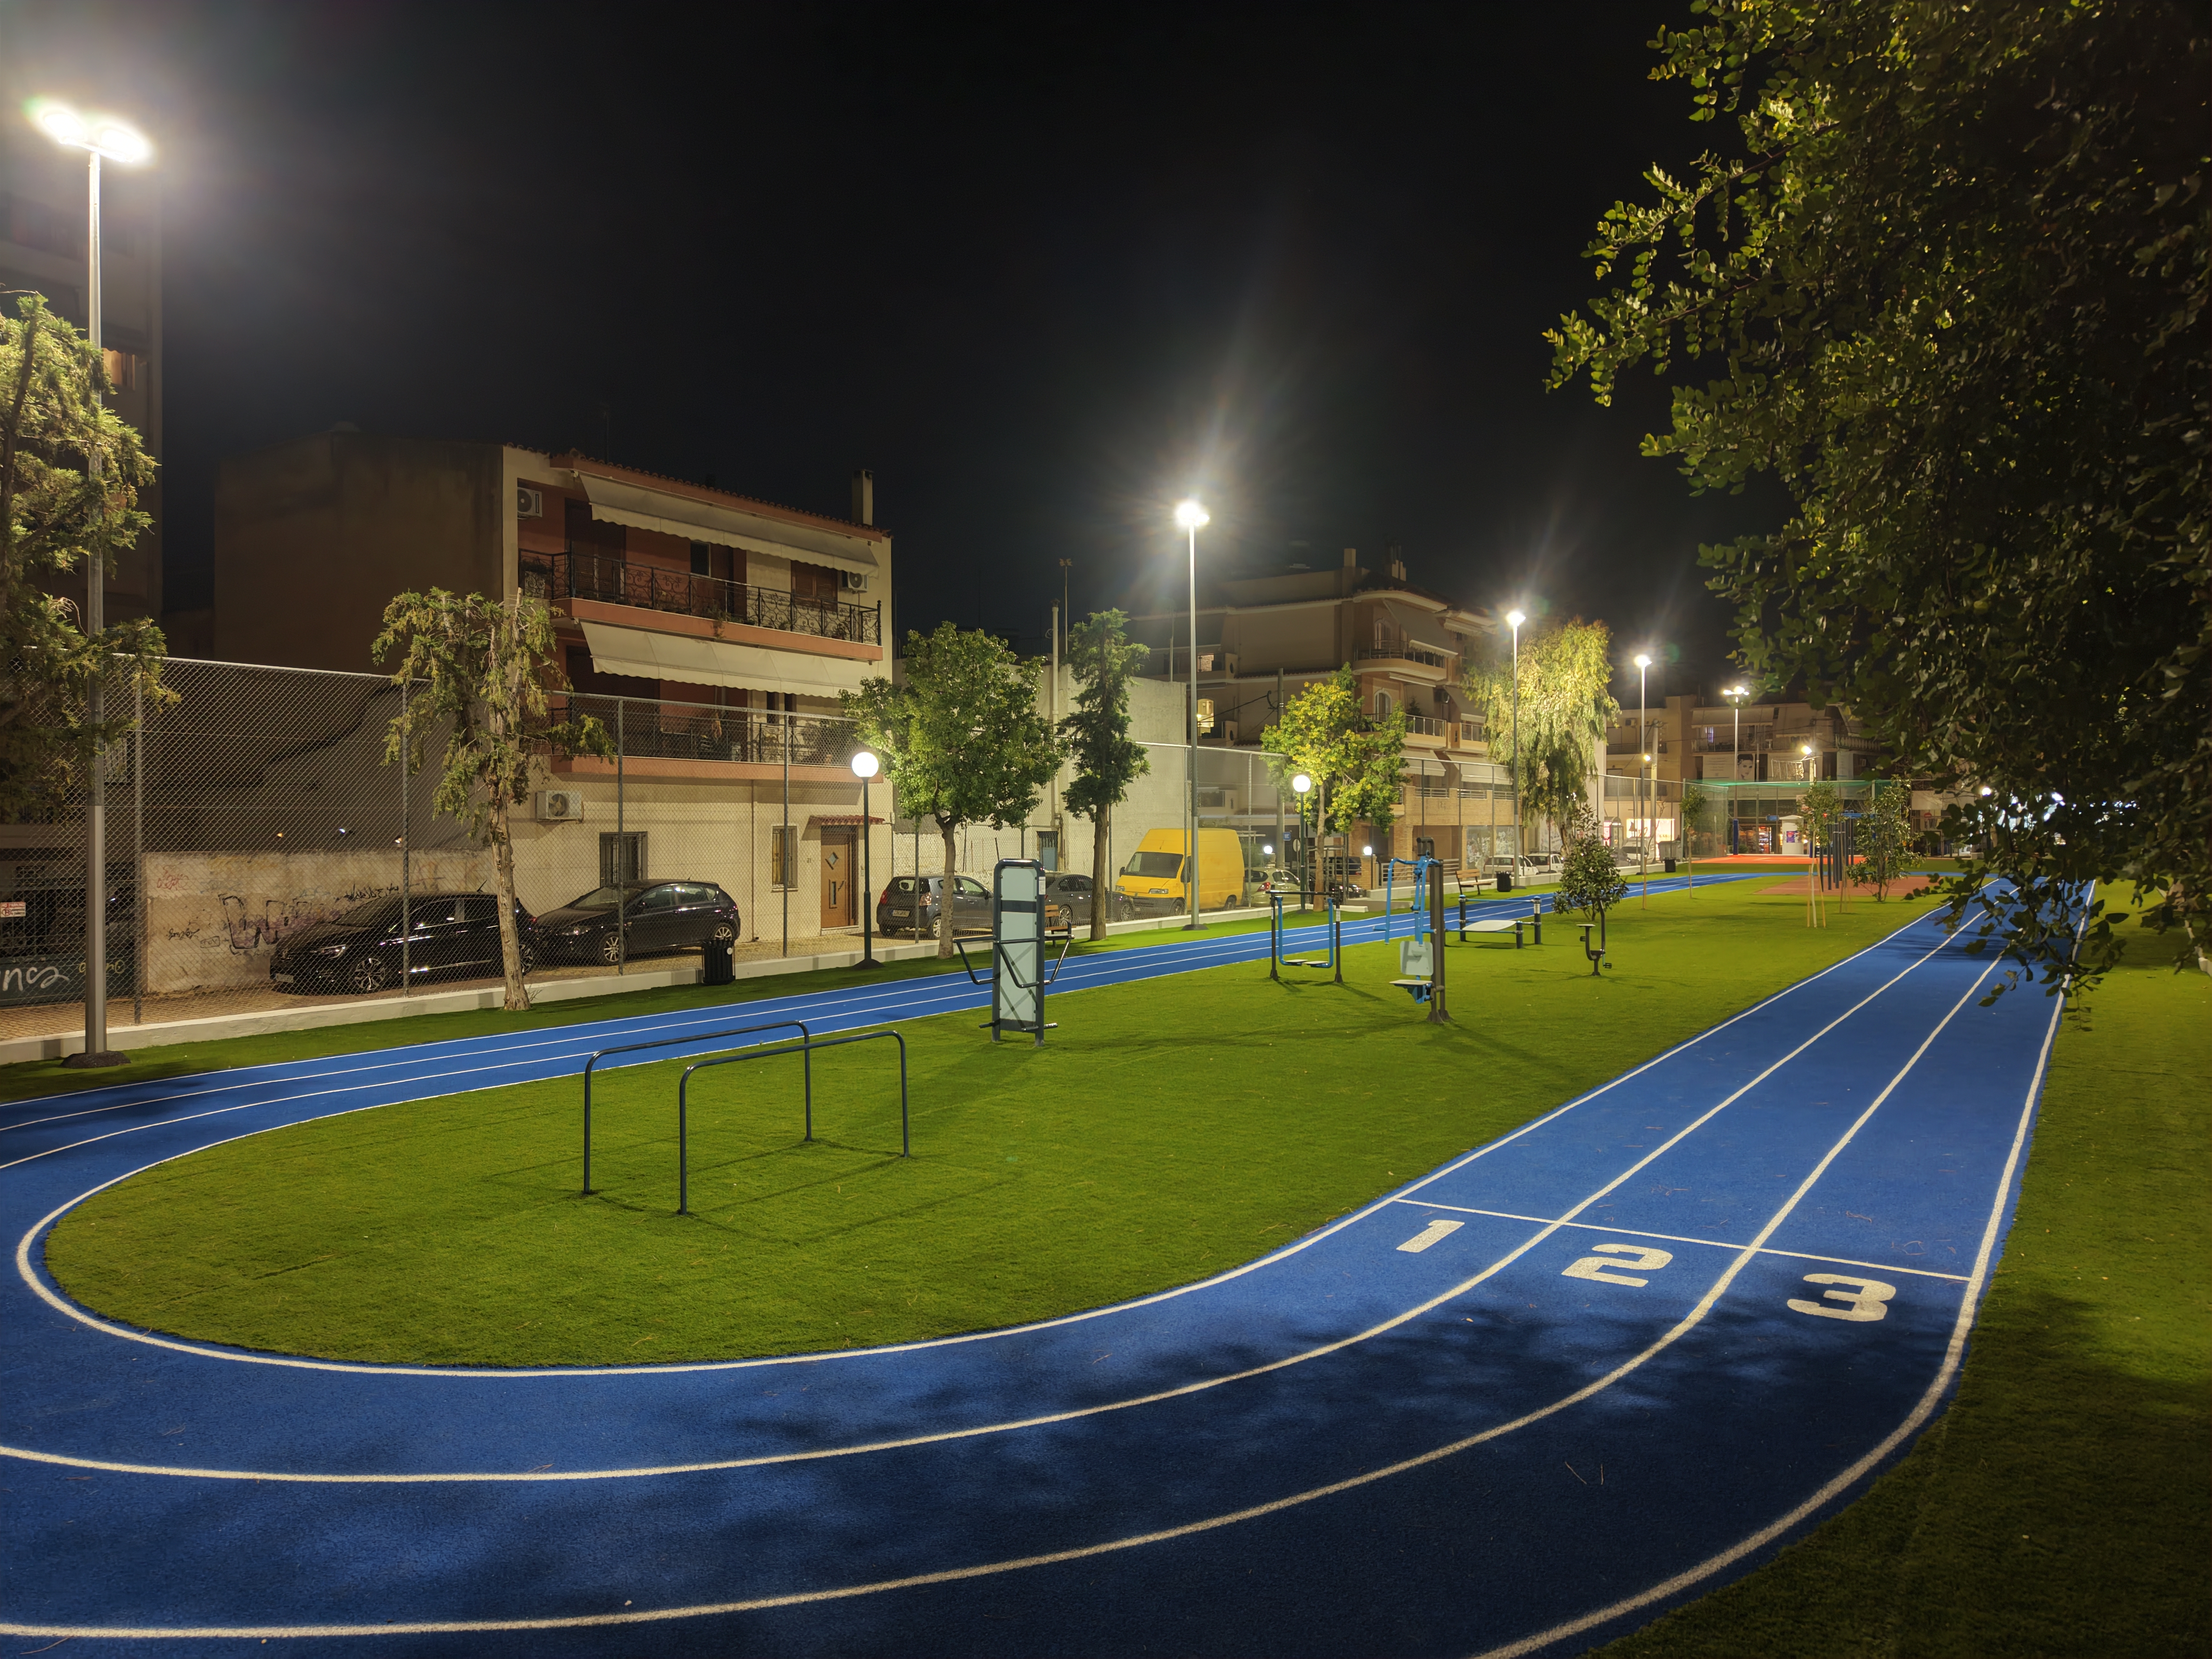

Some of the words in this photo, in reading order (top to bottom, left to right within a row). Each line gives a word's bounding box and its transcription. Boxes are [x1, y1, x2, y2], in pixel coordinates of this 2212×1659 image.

[1396, 1219, 1465, 1253] 1
[1561, 1243, 1674, 1288] 2
[1786, 1273, 1897, 1323] 3
